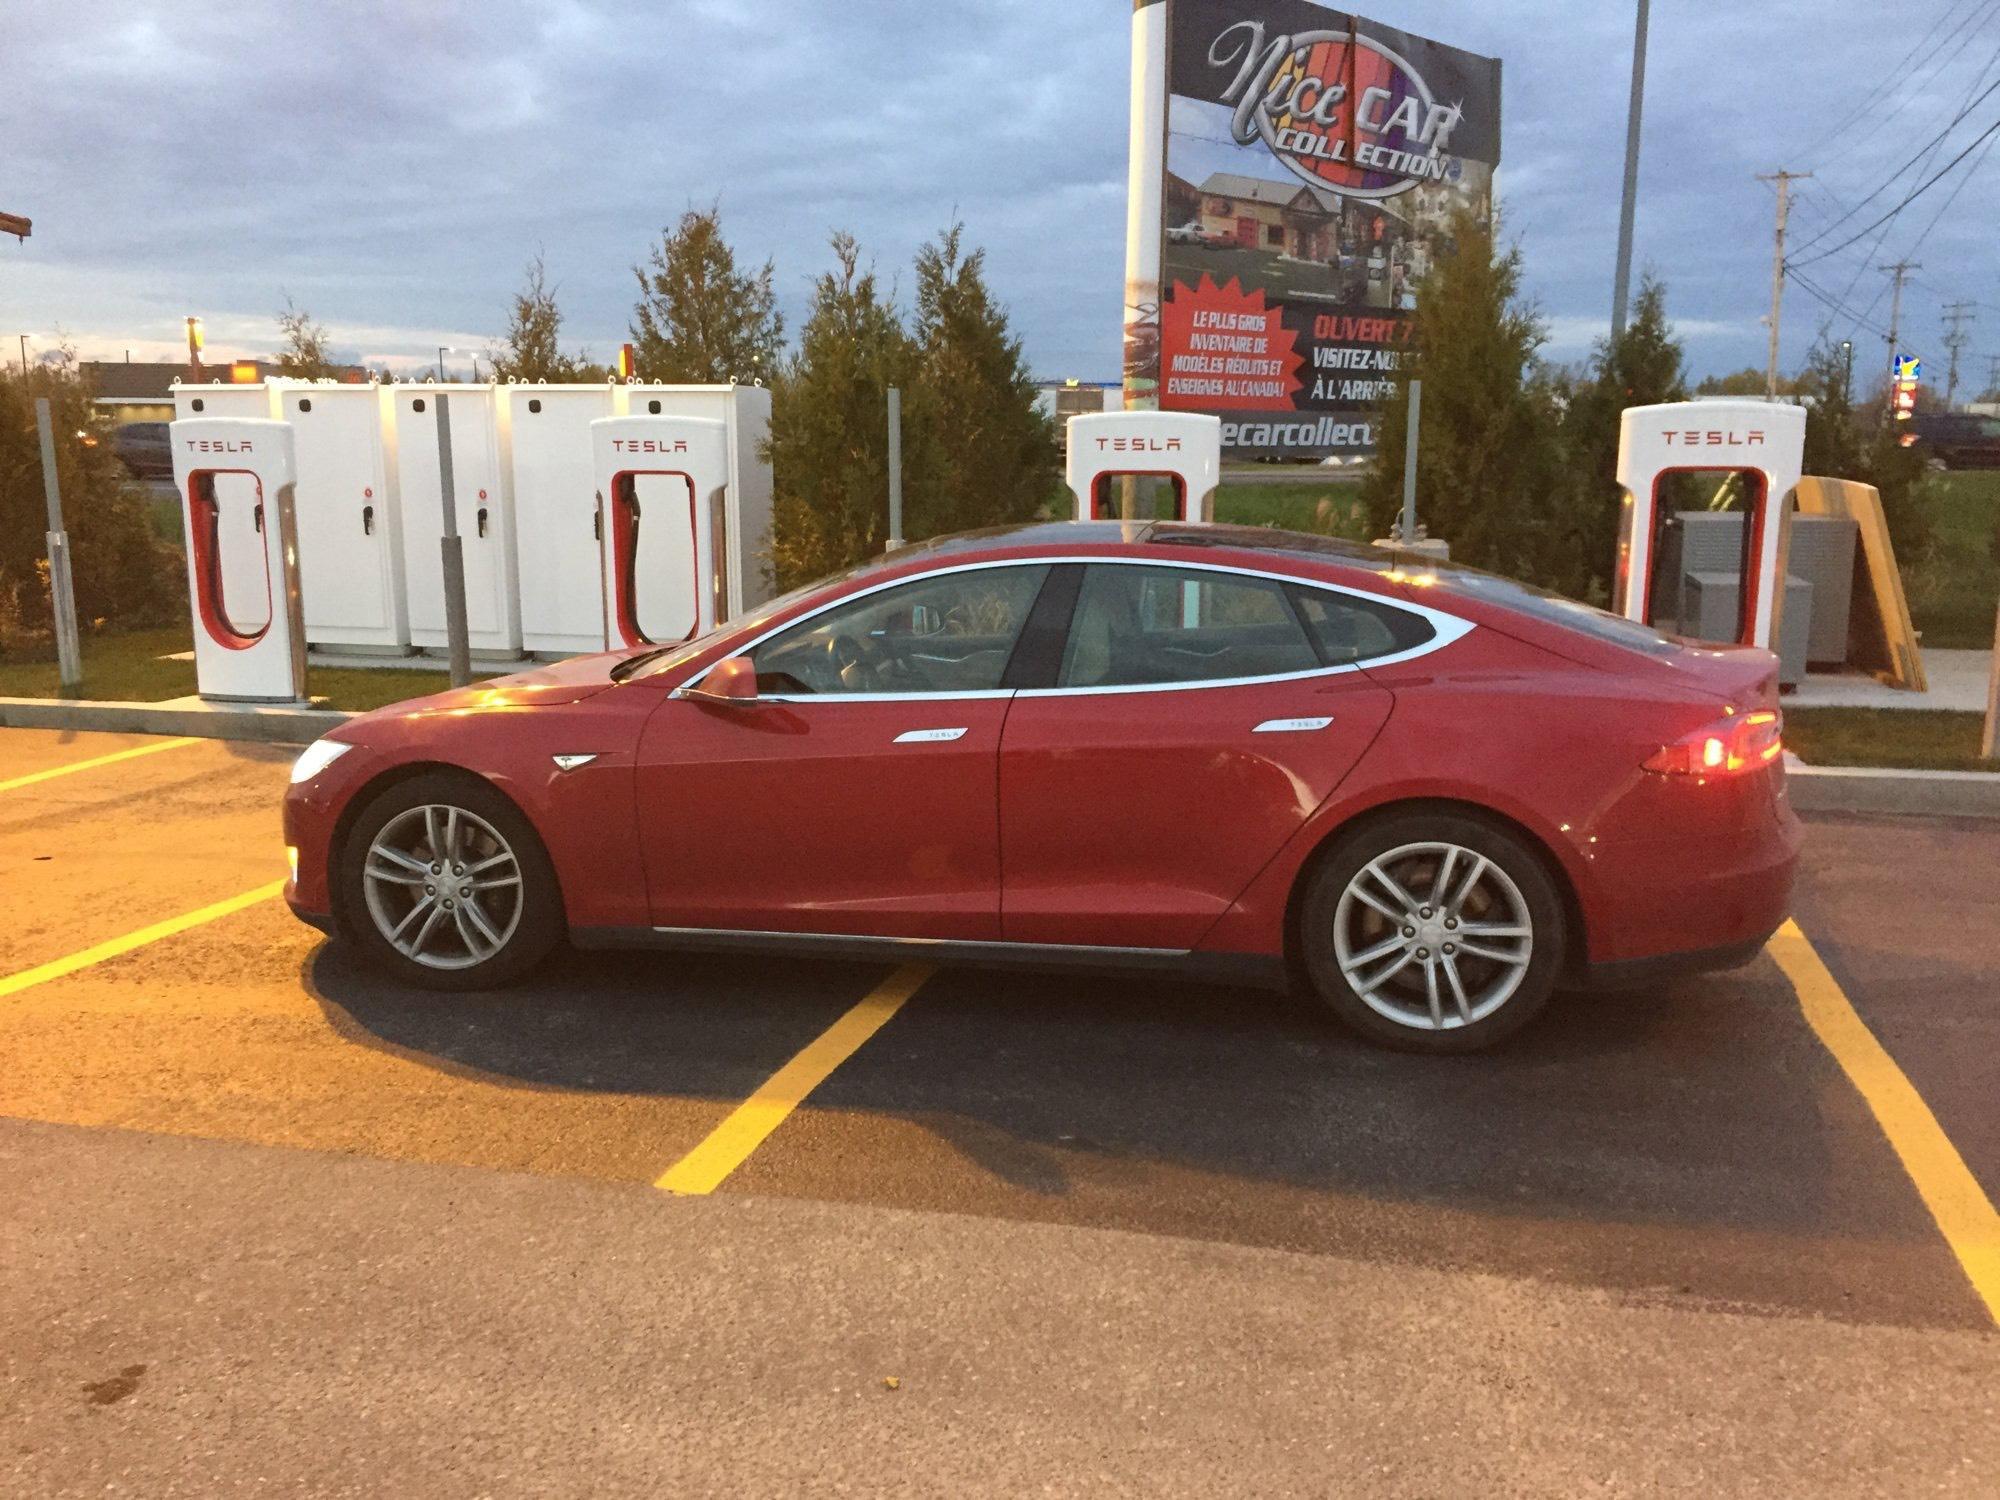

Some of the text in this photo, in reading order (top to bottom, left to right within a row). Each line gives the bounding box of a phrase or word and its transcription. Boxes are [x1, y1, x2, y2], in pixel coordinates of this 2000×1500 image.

[1207, 20, 1461, 158] Nice CAR
[1193, 311, 1266, 332] LE PLUS GROS
[1314, 315, 1396, 343] OUVERT
[1190, 333, 1268, 354] INVENTAIRE DE
[1269, 360, 1282, 376] ET
[1168, 377, 1224, 395] ENSEIGNES
[1224, 380, 1240, 396] AU
[1311, 373, 1324, 400] À
[187, 441, 253, 452] TESLA
[612, 440, 688, 452] TESLA
[1095, 438, 1181, 451] TESLA
[1661, 431, 1765, 445] TESLA
